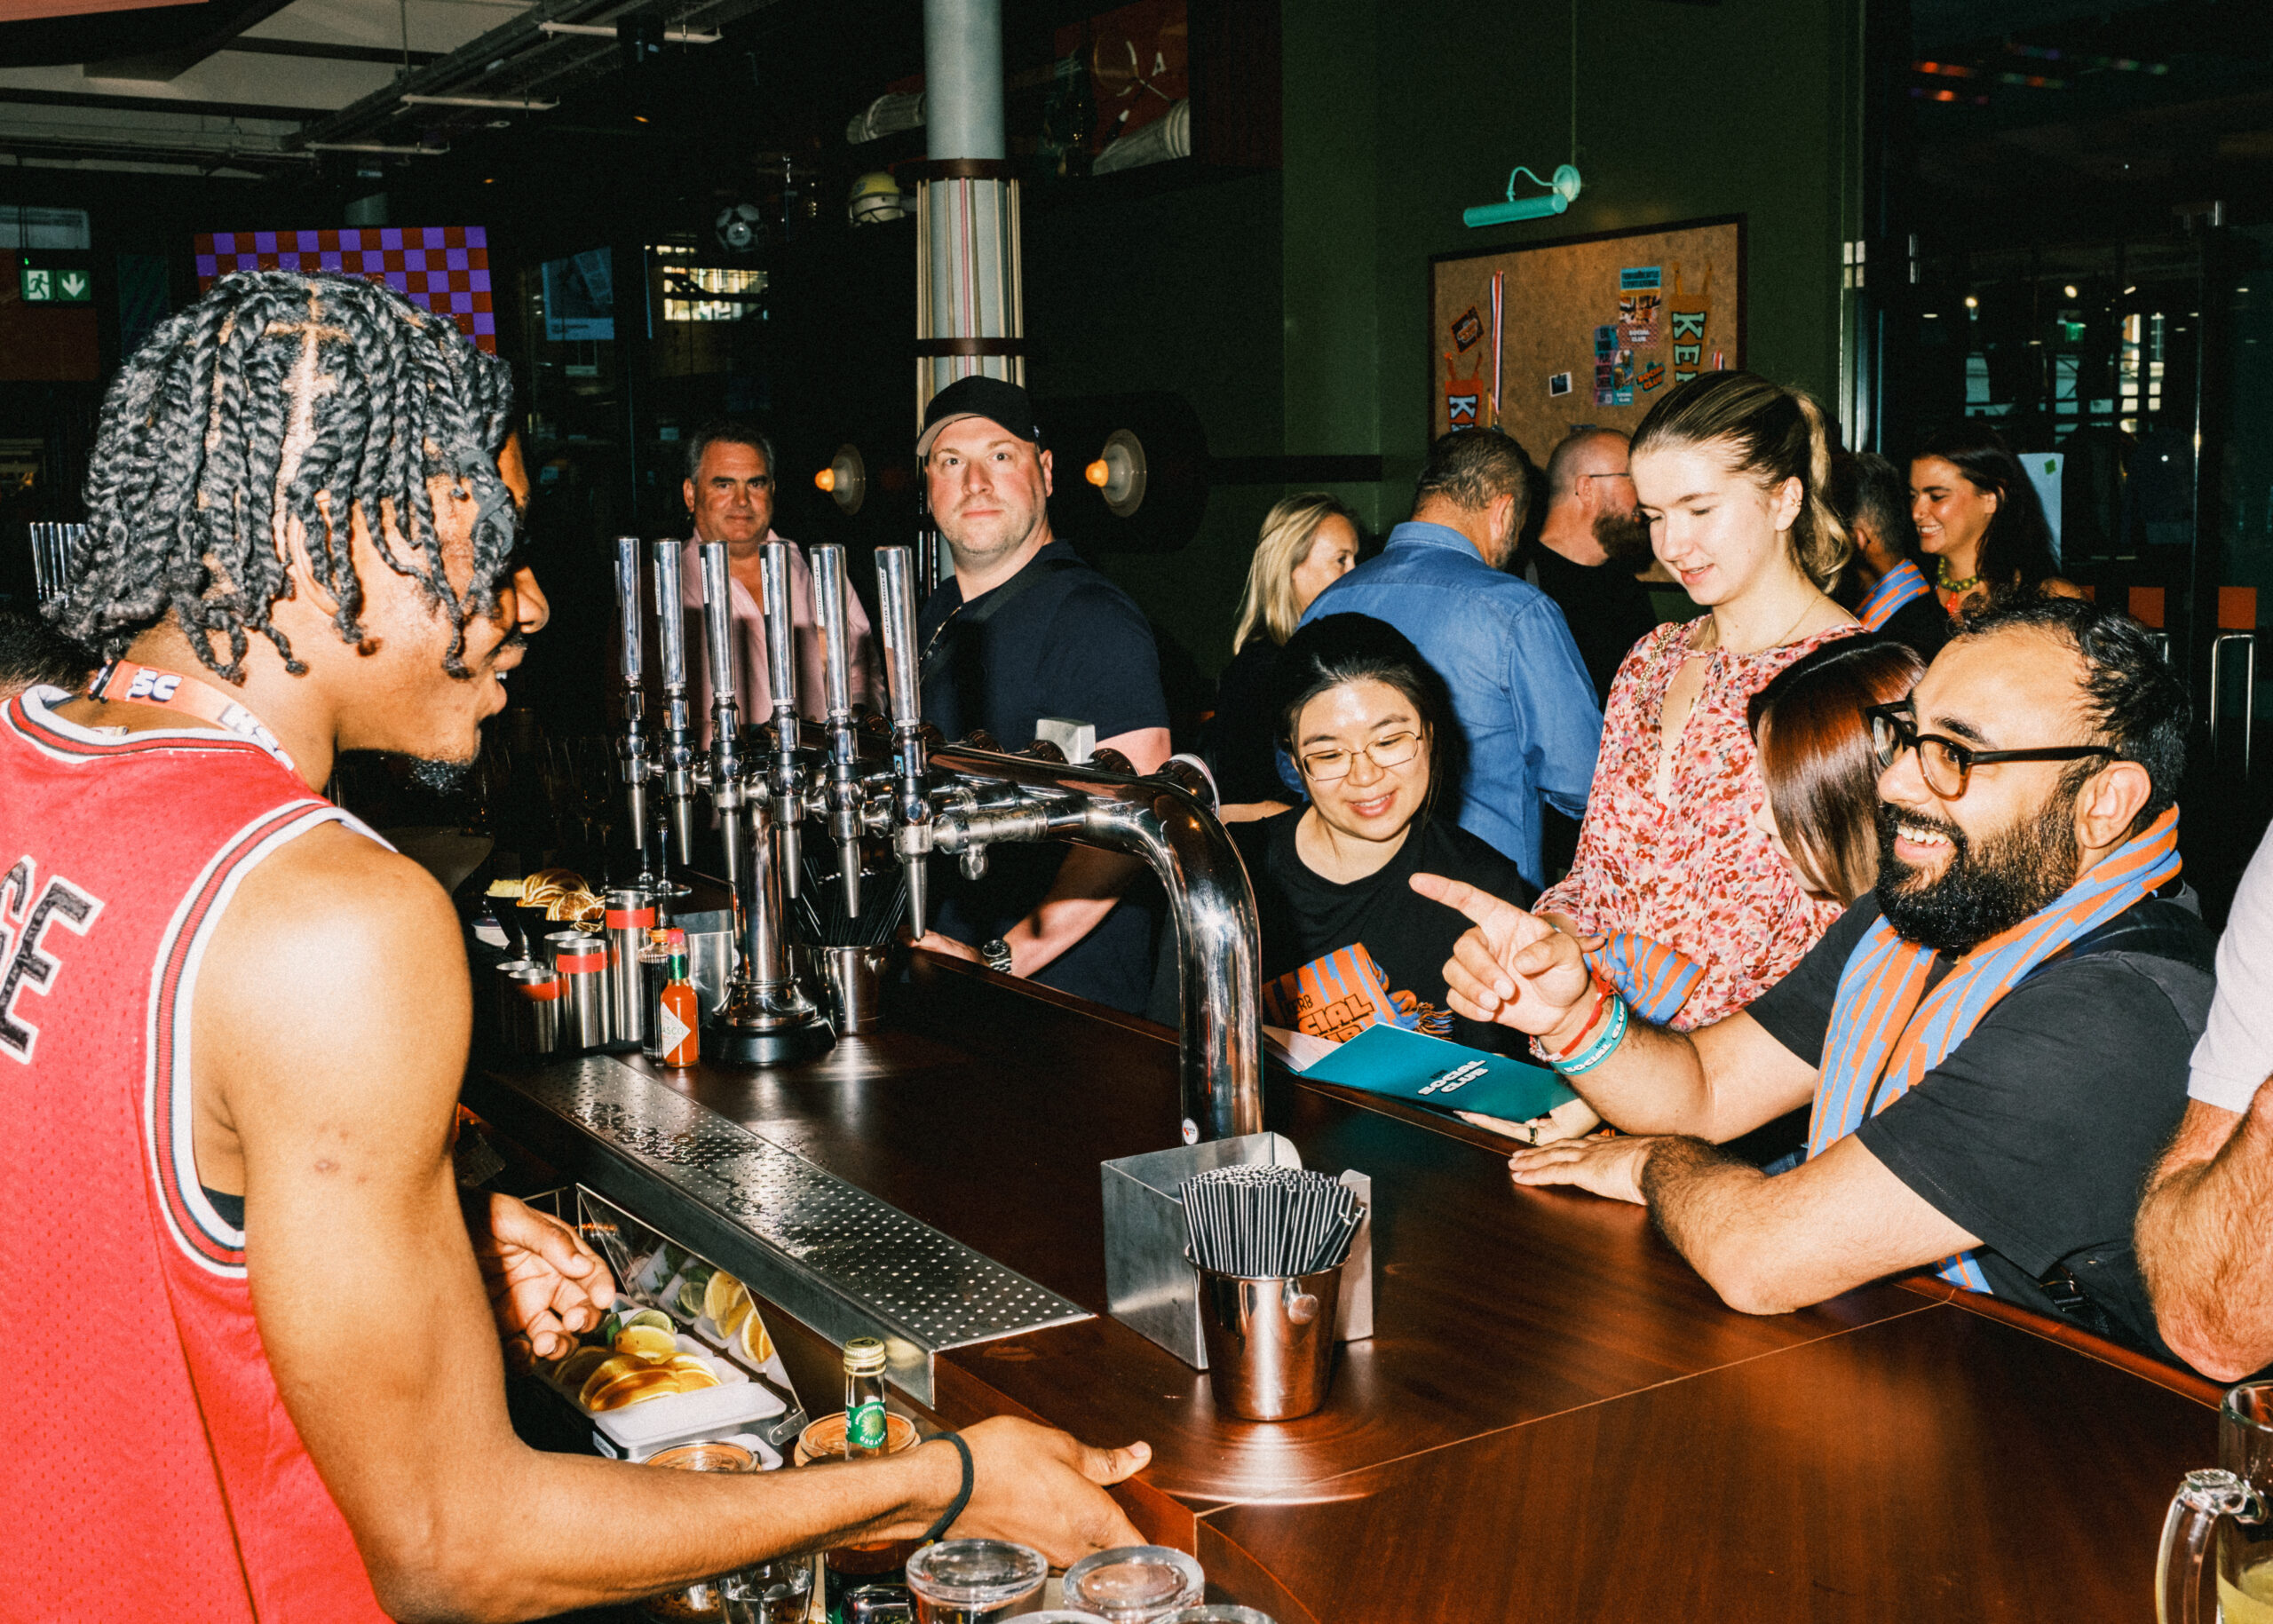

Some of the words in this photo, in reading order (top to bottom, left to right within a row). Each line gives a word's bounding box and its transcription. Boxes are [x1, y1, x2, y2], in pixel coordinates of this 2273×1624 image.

[1448, 395, 1478, 432] K
[1563, 1042, 1613, 1073] SOCIAL
[1417, 1059, 1487, 1096] SOCIAL
[1440, 1067, 1489, 1093] CLUB
